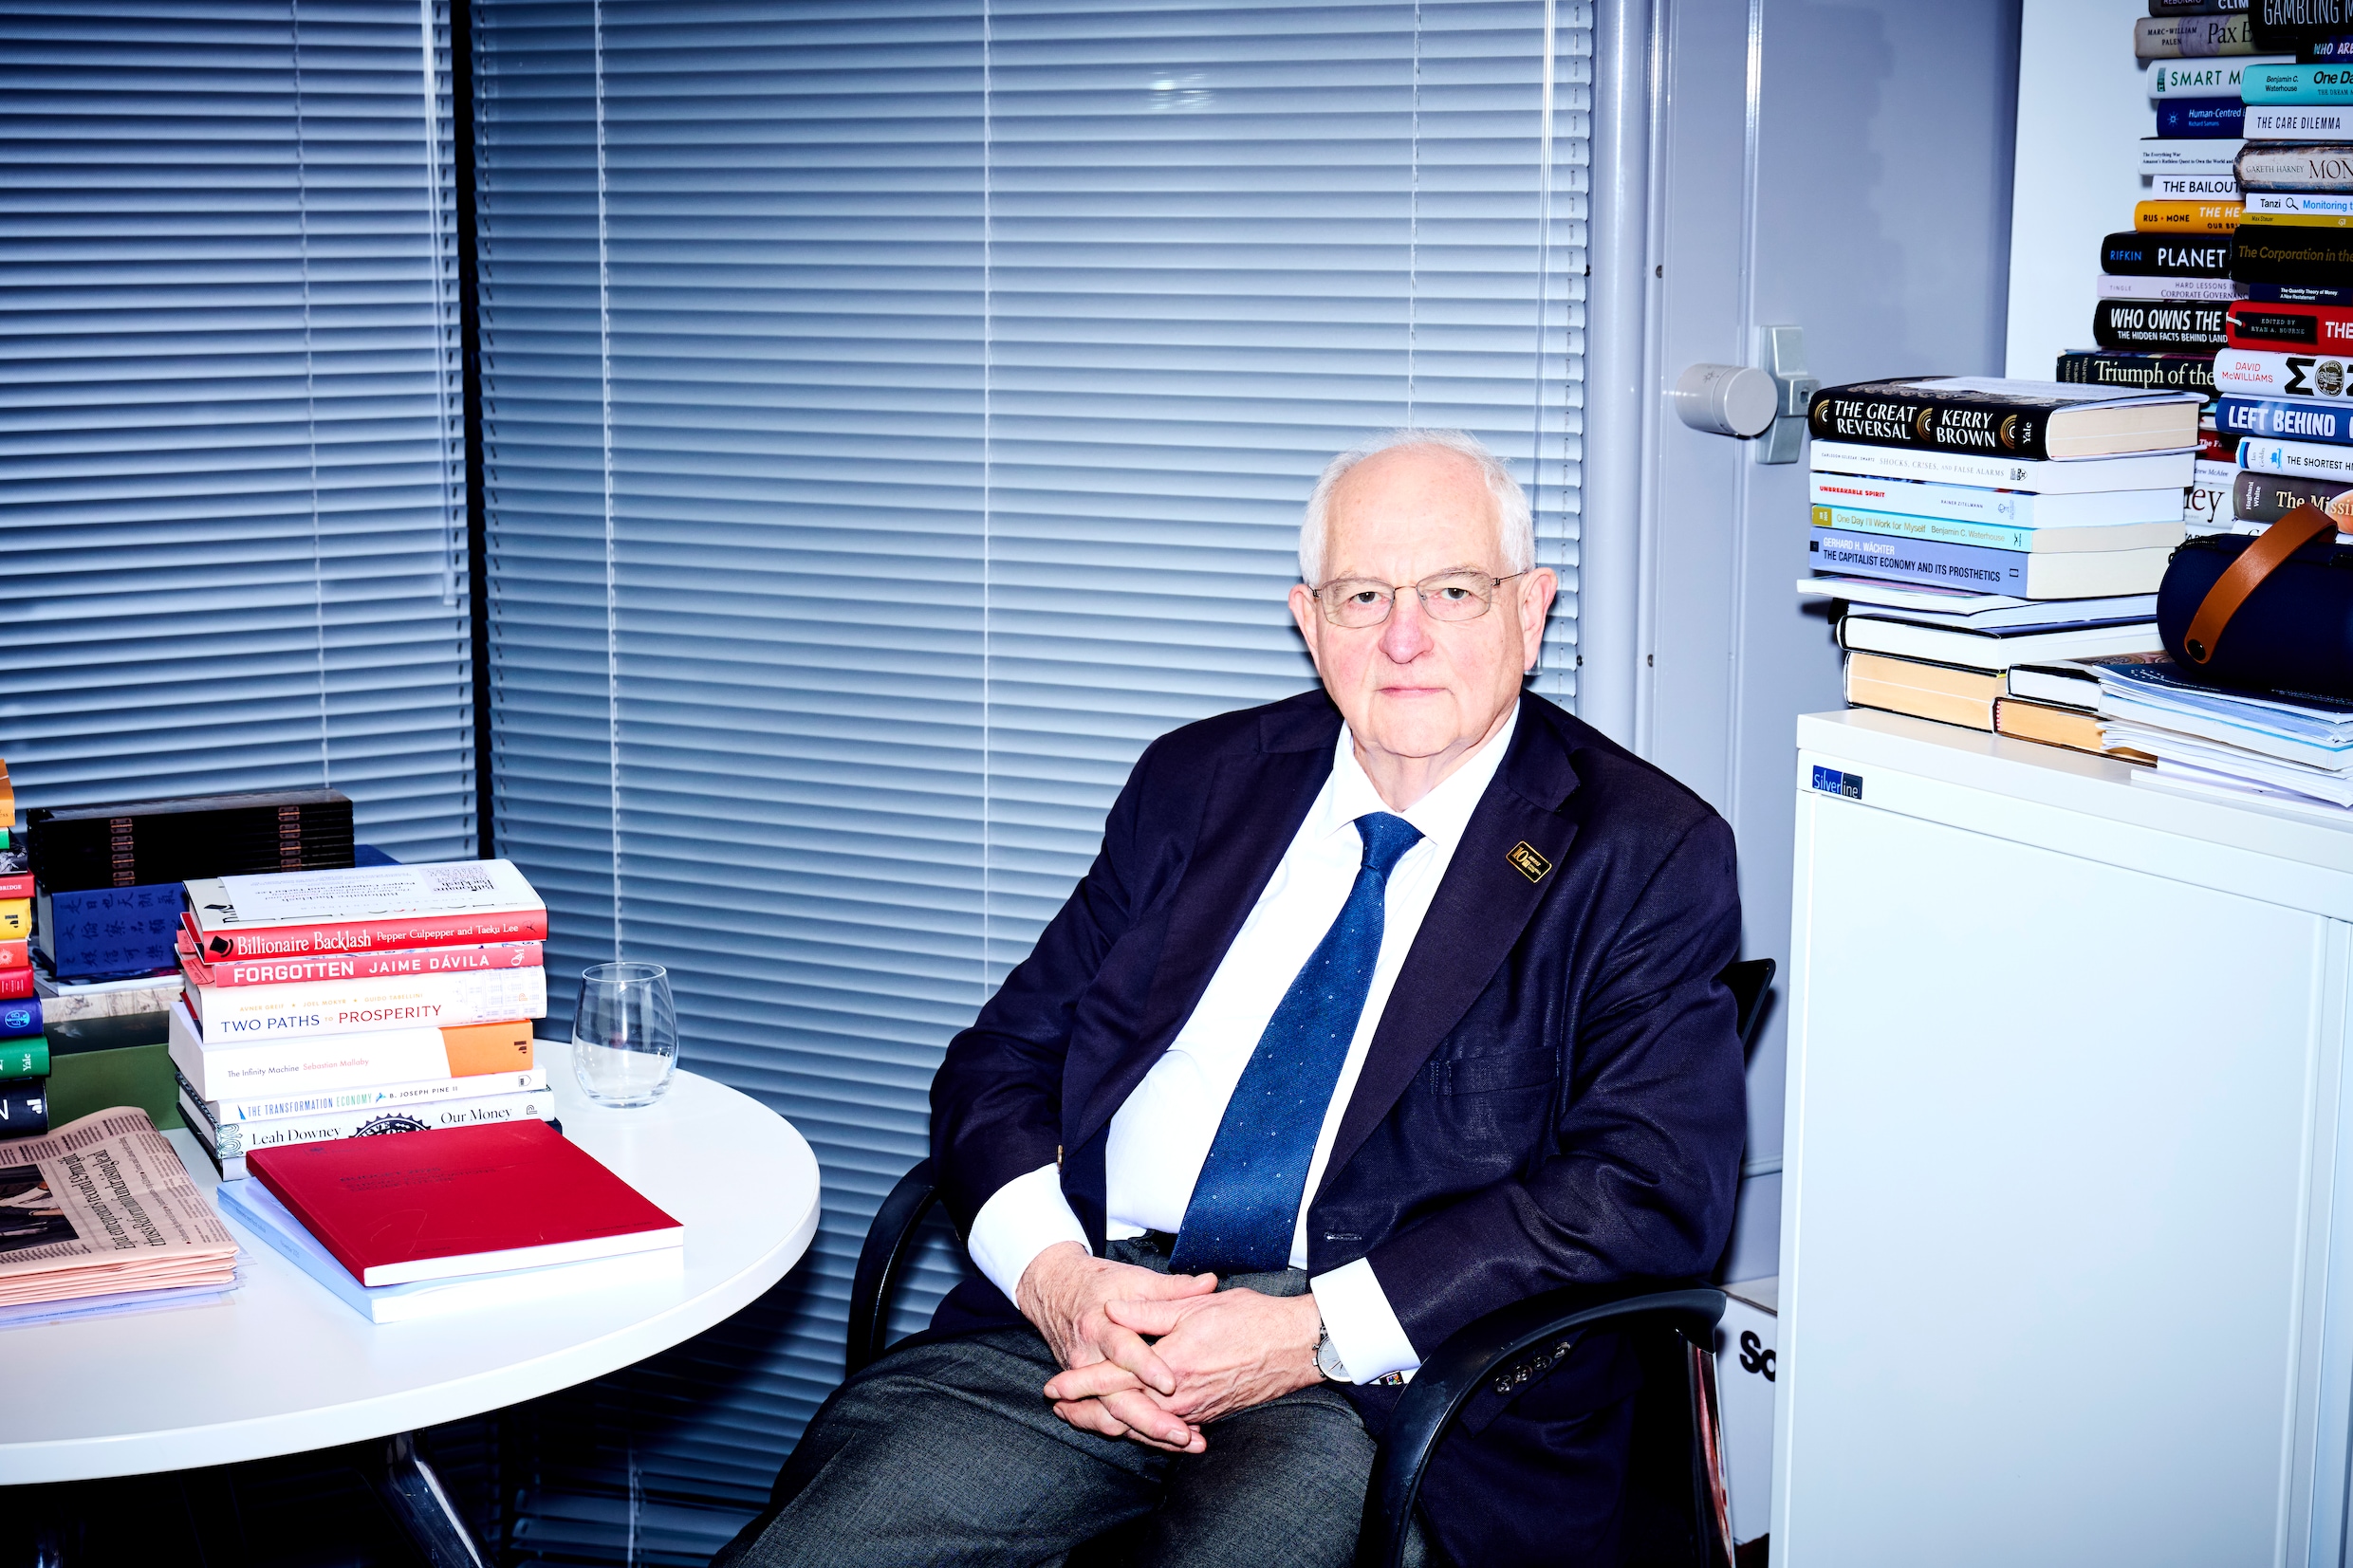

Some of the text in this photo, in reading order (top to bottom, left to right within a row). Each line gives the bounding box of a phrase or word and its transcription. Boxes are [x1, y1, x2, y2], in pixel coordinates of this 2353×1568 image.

[2264, 0, 2340, 25] GAMBLING
[2147, 28, 2197, 36] MARC-WILLIAM
[2207, 23, 2237, 45] Pax
[2313, 43, 2334, 55] WHO
[2171, 69, 2241, 86] SMART M
[2314, 71, 2338, 84] One
[2189, 108, 2242, 118] Human-Centred
[2257, 117, 2341, 130] THE CARE DILEMMA
[2246, 165, 2305, 174] GARETH HARNEY
[2163, 181, 2185, 194] THE
[2199, 207, 2221, 218] THE
[2260, 199, 2281, 208] Tanzi
[2303, 199, 2347, 212] Monitoring
[2110, 250, 2142, 261] RIFKIN
[2158, 248, 2227, 268] PLANET
[2239, 245, 2258, 258] The
[2259, 247, 2324, 263] Corporation
[2325, 249, 2336, 262] in
[2160, 289, 2201, 299] CORPORATE
[2111, 308, 2222, 331] WHO OWNS THE
[2118, 331, 2229, 343] THE HIDDEN FACTS BEHIND LAND
[2325, 321, 2353, 339] THE
[2094, 360, 2214, 389] Triumph of the
[2235, 361, 2261, 372] DAVID
[2221, 372, 2273, 383] McWILLIAMS
[1834, 400, 1918, 423] THE GREAT
[1941, 409, 1993, 429] KERRY
[2228, 405, 2269, 431] LEFT
[2273, 409, 2336, 437] BEHIND
[1837, 417, 1911, 440] REVERSAL
[1936, 427, 1996, 448] BROWN
[2023, 421, 2032, 445] Yale
[1880, 457, 1910, 468] SHOCKS,
[1954, 465, 1974, 474] FALSE
[1976, 468, 2005, 477] ALARMS
[2288, 455, 2301, 466] THE
[2304, 459, 2343, 470] SHORTEST
[1819, 486, 1863, 496] UNBREAKABLE
[2246, 481, 2254, 510] Haghani
[2253, 486, 2262, 507] White
[2275, 490, 2306, 509] The
[1837, 513, 1850, 524] One
[1851, 516, 1864, 527] Day
[1874, 518, 1891, 529] Work
[1892, 520, 1901, 530] for
[1903, 522, 1926, 534] Myself
[1931, 526, 1959, 537] Benjamin
[1960, 529, 1968, 538] C.
[1968, 530, 2006, 542] Waterhouse
[1824, 537, 1895, 556] GERHARD H. WÄCHTER
[1824, 549, 2001, 582] THE CAPITALIST ECONOMY AND ITS PROSTHETICS
[1813, 769, 1859, 799] Silverline
[237, 923, 519, 955] Billionaire Backlash Pepper Culpepper and Taeku Lee
[233, 954, 490, 984] FORGOTTEN JAIME DÁVILA
[322, 998, 347, 1006] MOKYR
[221, 1019, 261, 1033] TWO
[267, 1014, 320, 1029] PATHS
[339, 1005, 442, 1024] PROSPERITY
[22, 1053, 31, 1072] Yale
[242, 1066, 267, 1077] Infinity
[268, 1064, 300, 1074] Machine
[303, 1061, 338, 1071] Sebastian
[340, 1058, 369, 1067] Mallaby
[399, 1089, 429, 1098] JOSEPH
[432, 1087, 450, 1096] PINE
[248, 1093, 373, 1117] THE TRANSFORMATION ECONOMY
[440, 1107, 512, 1124] Our Money
[252, 1127, 342, 1146] Leah Downey
